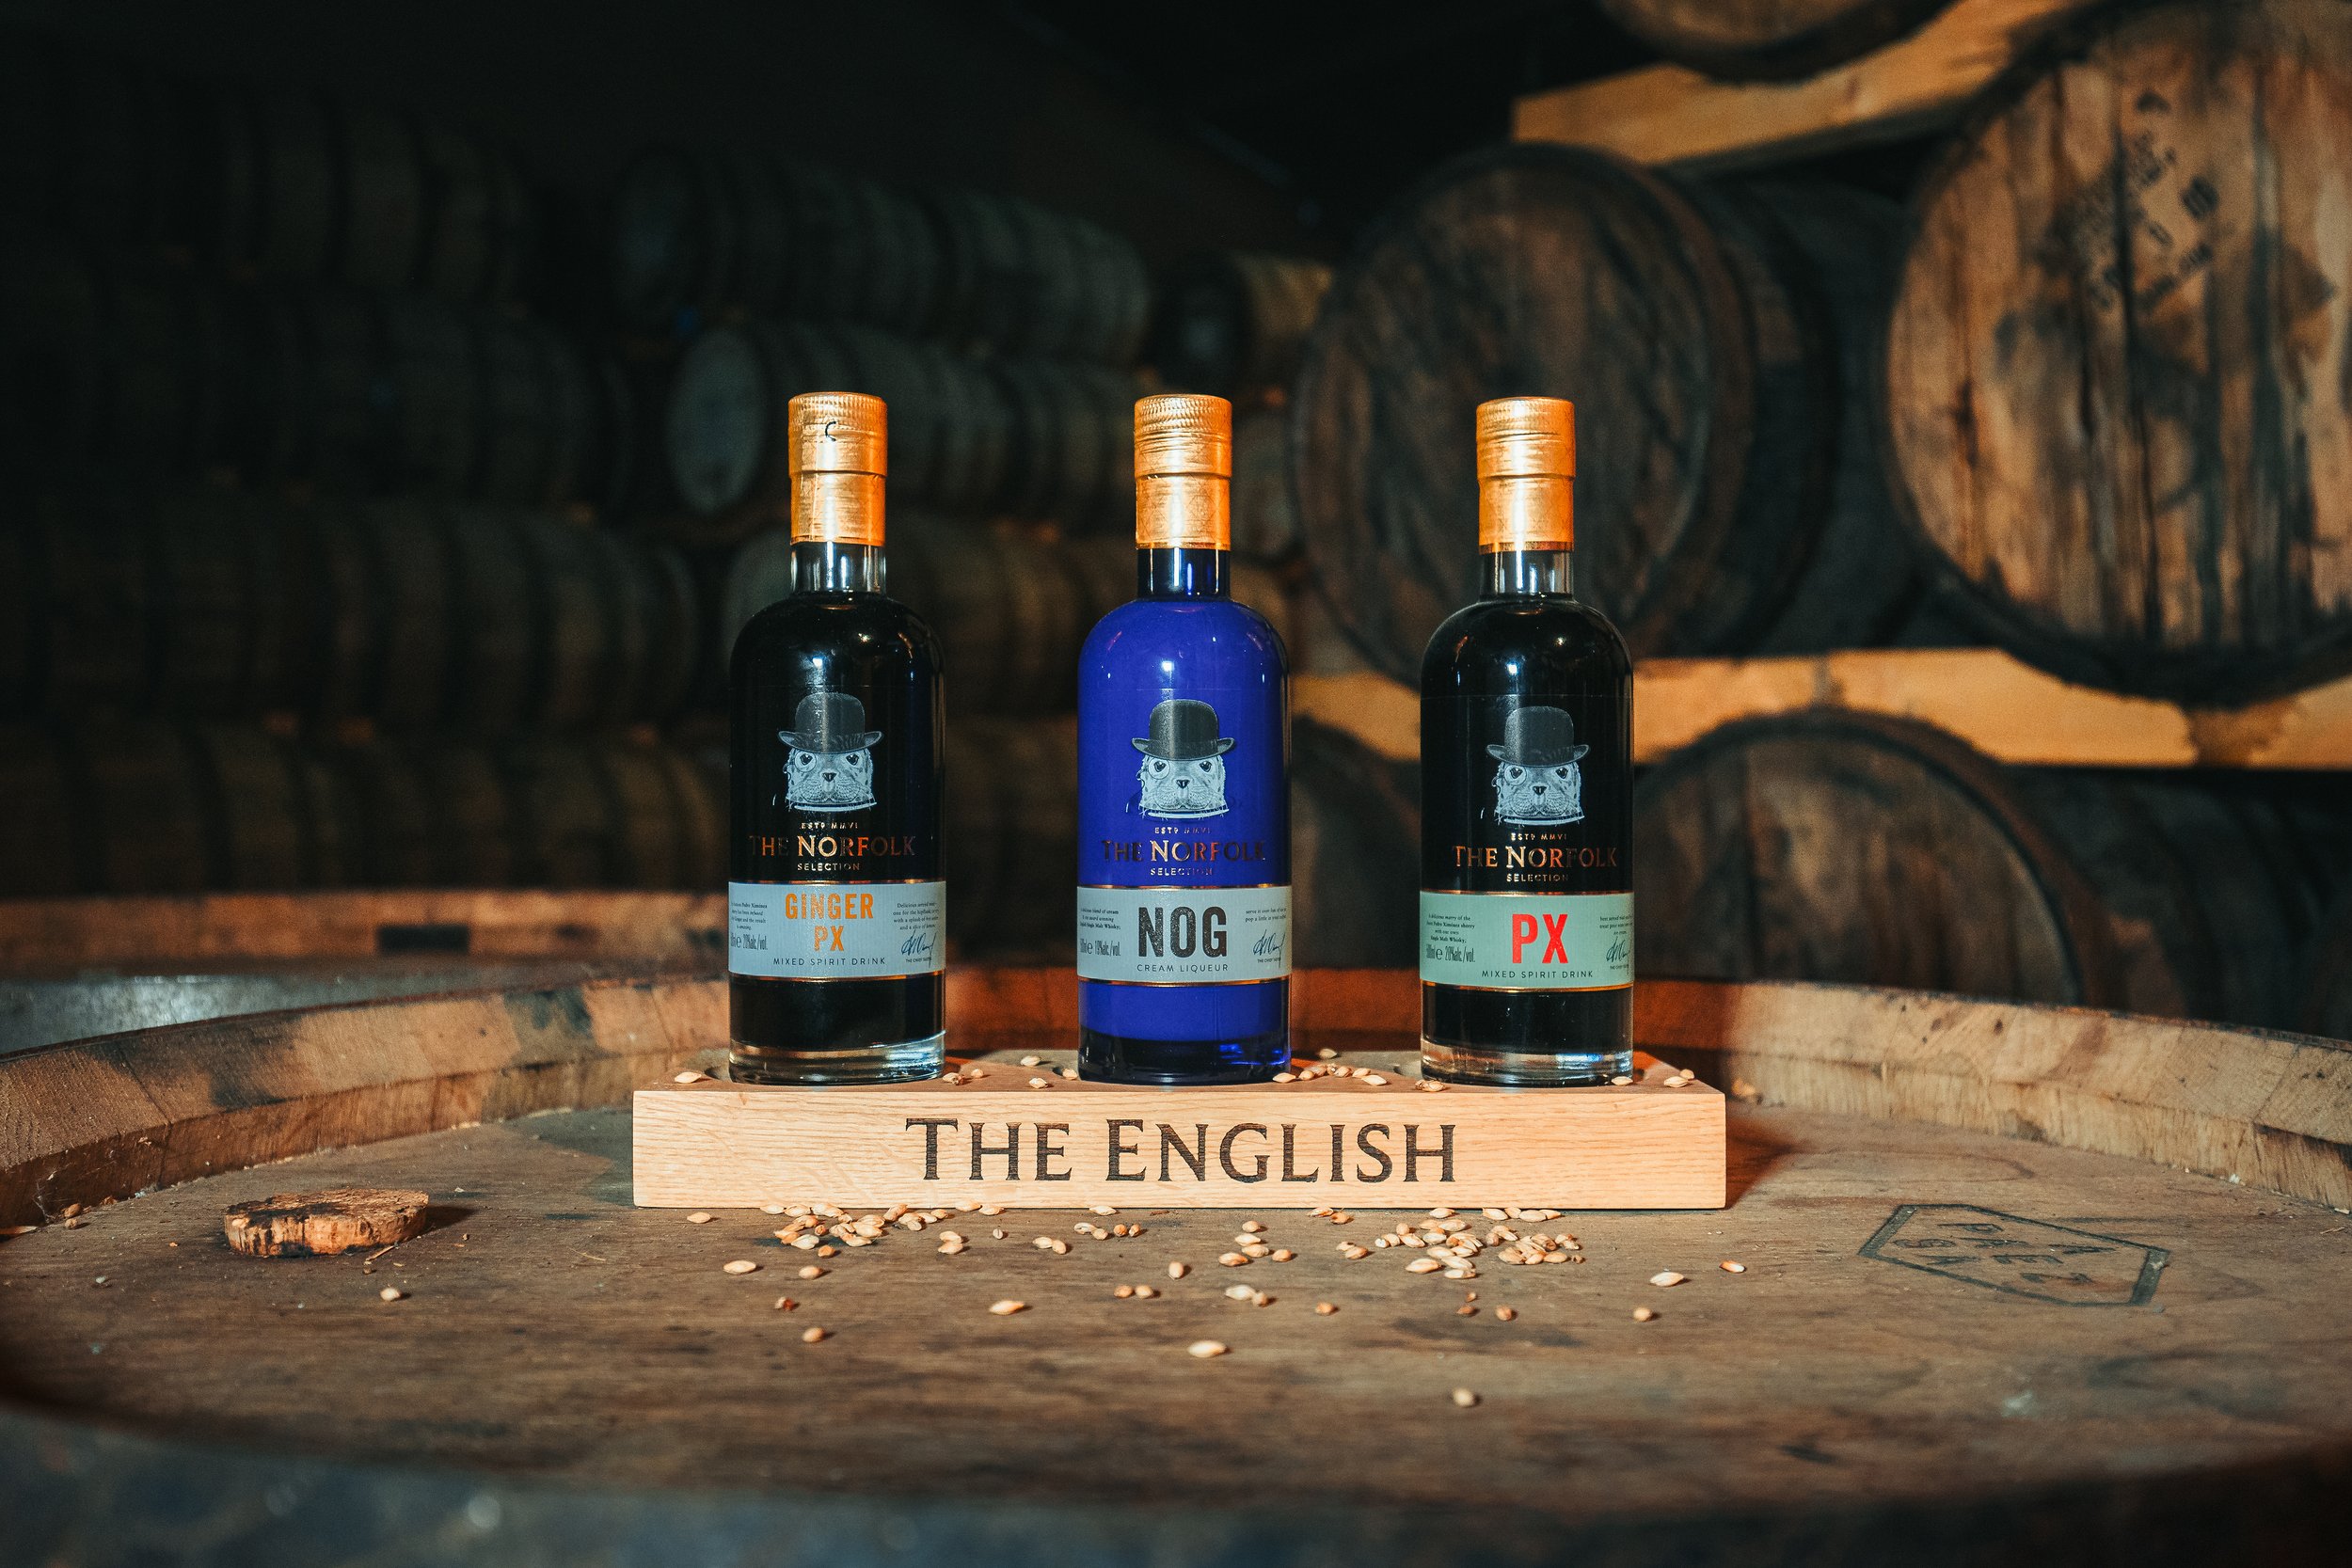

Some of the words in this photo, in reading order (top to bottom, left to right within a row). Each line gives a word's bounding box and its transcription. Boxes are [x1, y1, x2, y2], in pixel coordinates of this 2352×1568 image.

[749, 835, 789, 857] THE
[797, 835, 916, 857] NORFOLK
[1540, 832, 1567, 841] MMVI
[1101, 840, 1145, 862] THE
[1150, 840, 1266, 862] NORFOLK
[1453, 846, 1499, 868] THE
[1505, 846, 1618, 868] NORFOLK
[797, 863, 860, 871] SELECTION
[1150, 867, 1214, 876] SELECTION
[1506, 873, 1569, 882] SELECTION
[785, 893, 874, 920] GINGER
[814, 926, 844, 952] PX
[1137, 906, 1228, 958] NOG
[1512, 913, 1568, 964] PX
[773, 958, 805, 966] MIXED
[810, 958, 846, 966] SPIRIT
[851, 957, 885, 965] DRINK
[1136, 964, 1174, 973] CREAM
[1180, 964, 1229, 974] LIQUEUR
[1482, 971, 1516, 979] MIXED
[1521, 971, 1557, 979] SPIRIT
[1562, 970, 1594, 978] DRINK
[905, 1117, 1073, 1181] THE
[1105, 1118, 1457, 1184] ENGLISH
